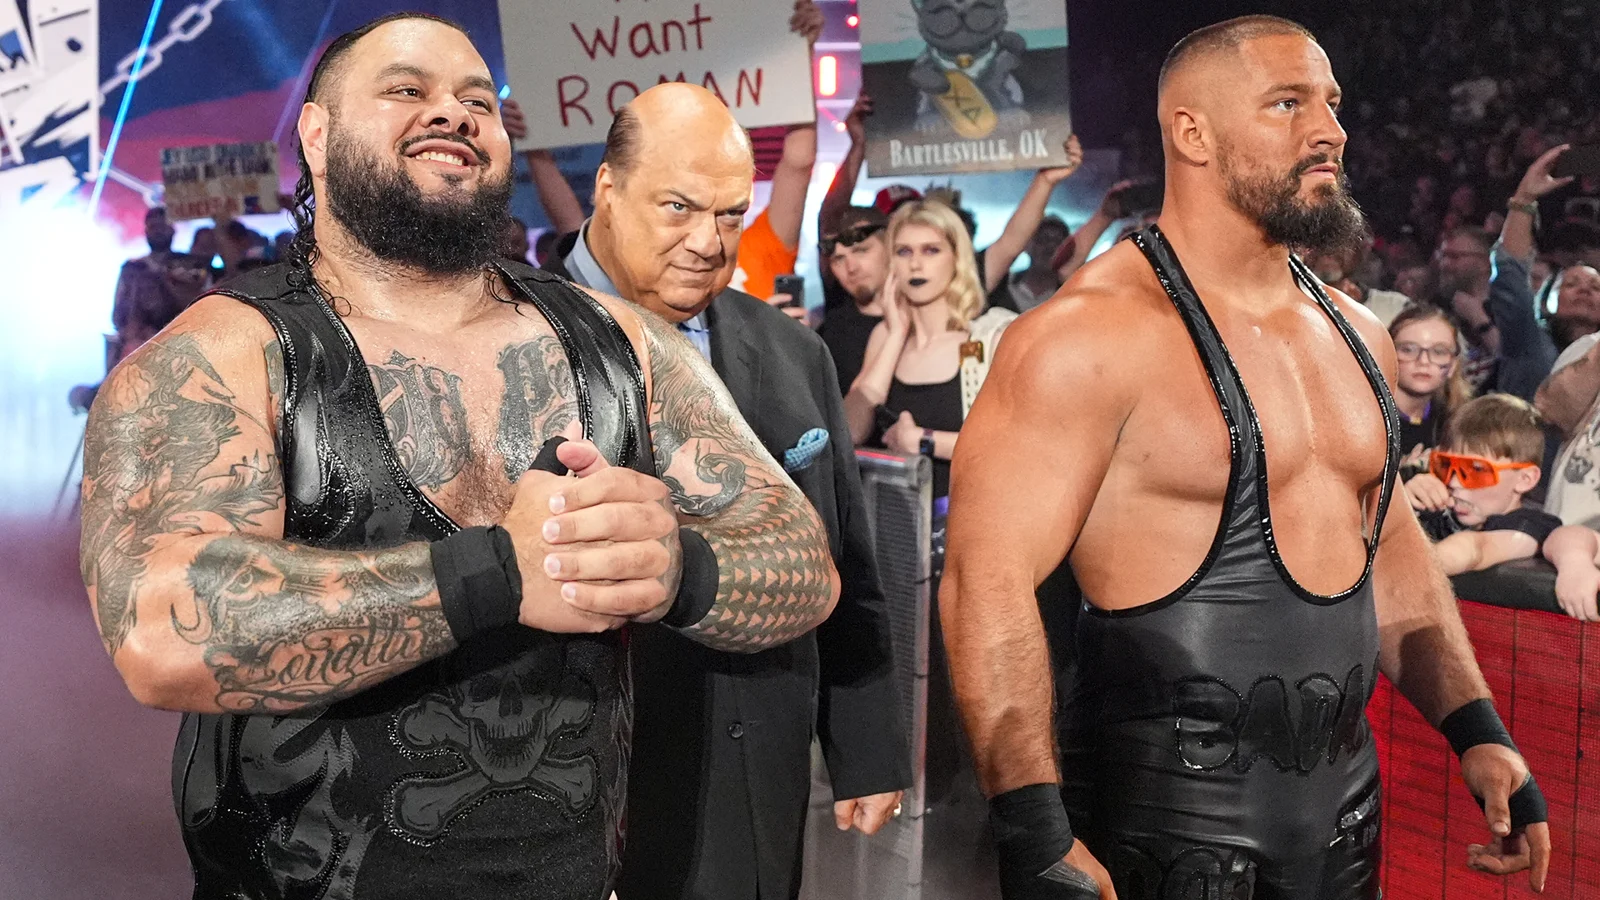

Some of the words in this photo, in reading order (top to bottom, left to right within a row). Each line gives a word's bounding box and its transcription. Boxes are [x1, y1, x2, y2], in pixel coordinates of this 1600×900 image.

[570, 3, 713, 61] Want
[557, 68, 763, 127] ROAN
[1019, 128, 1049, 159] OK
